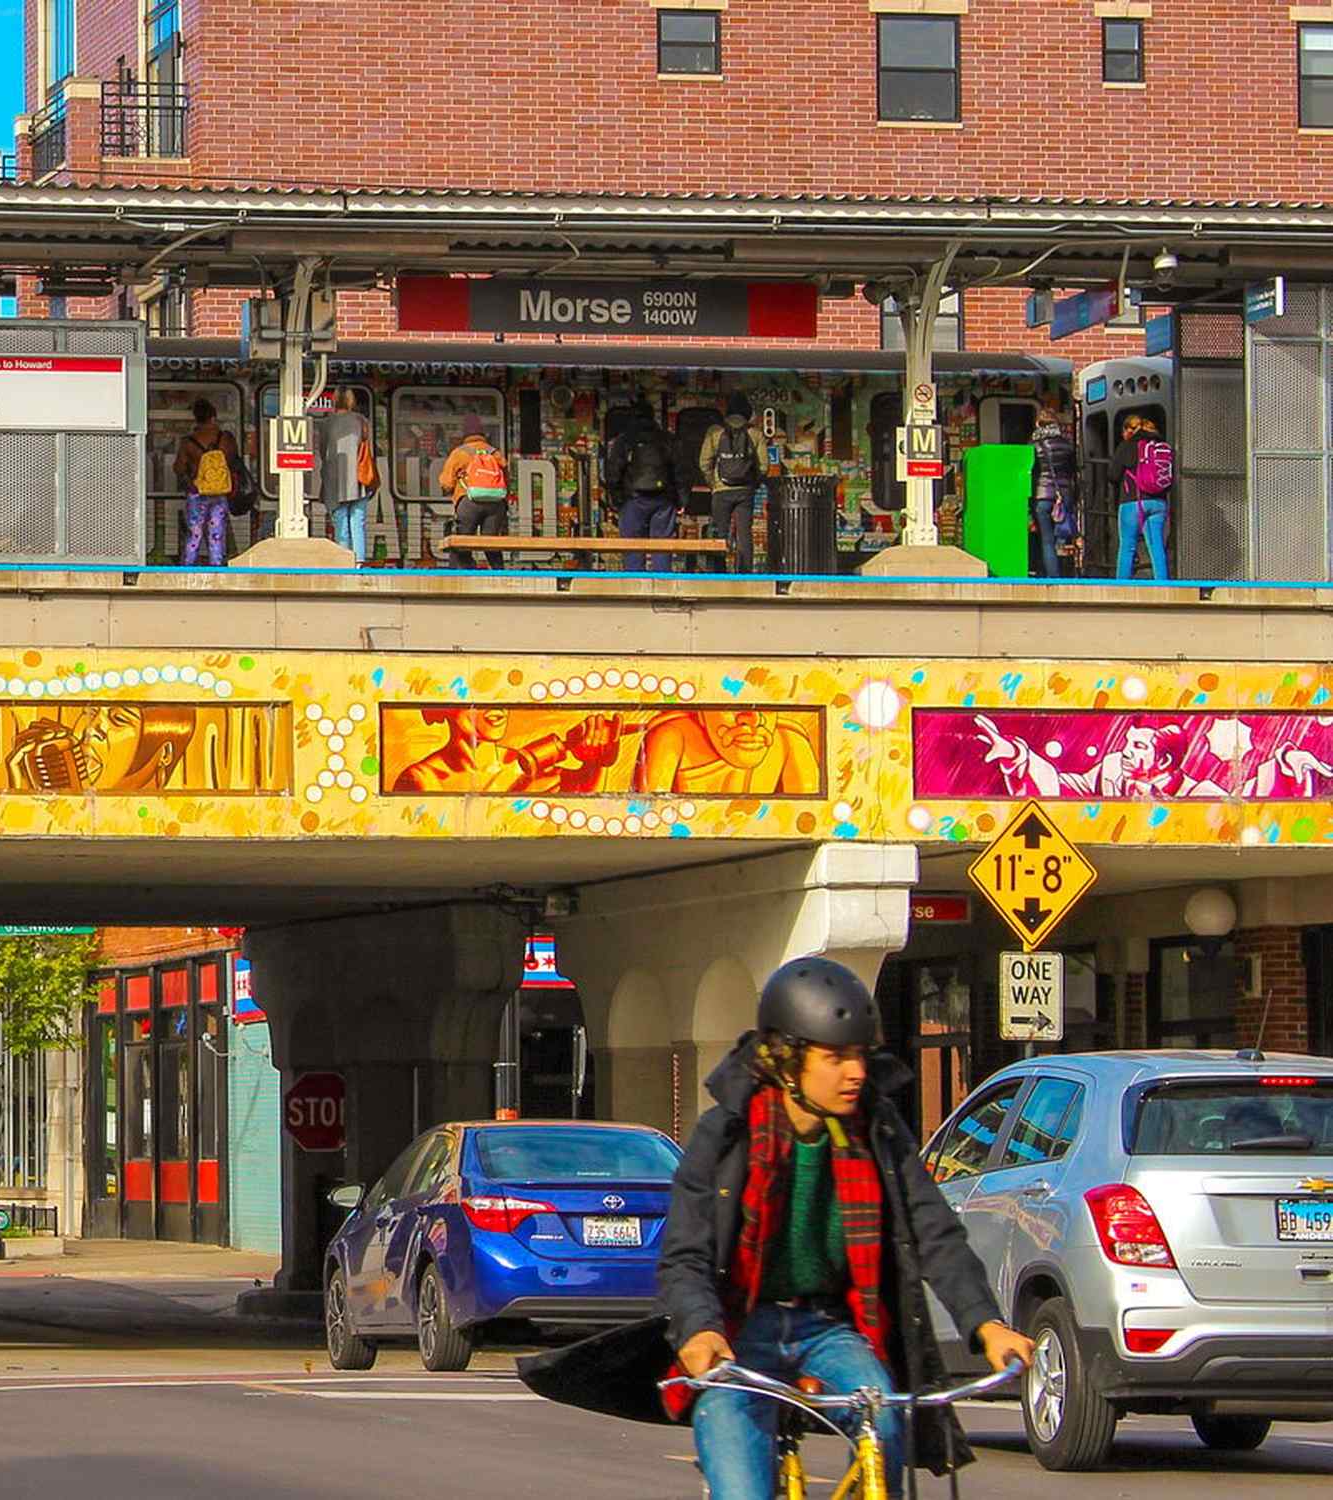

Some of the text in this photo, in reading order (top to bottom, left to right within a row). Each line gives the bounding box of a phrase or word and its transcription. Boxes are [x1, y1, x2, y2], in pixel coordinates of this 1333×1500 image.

[520, 289, 632, 323] Morse
[643, 291, 697, 308] 6900N
[643, 309, 697, 325] 1400W
[2, 359, 13, 369] to
[15, 360, 52, 370] Howard
[148, 356, 214, 371] OOSE
[378, 360, 491, 376] COMPANY
[283, 420, 307, 444] M
[913, 428, 936, 452] M
[1011, 960, 1052, 981] ONE
[1011, 986, 1052, 1005] WAY
